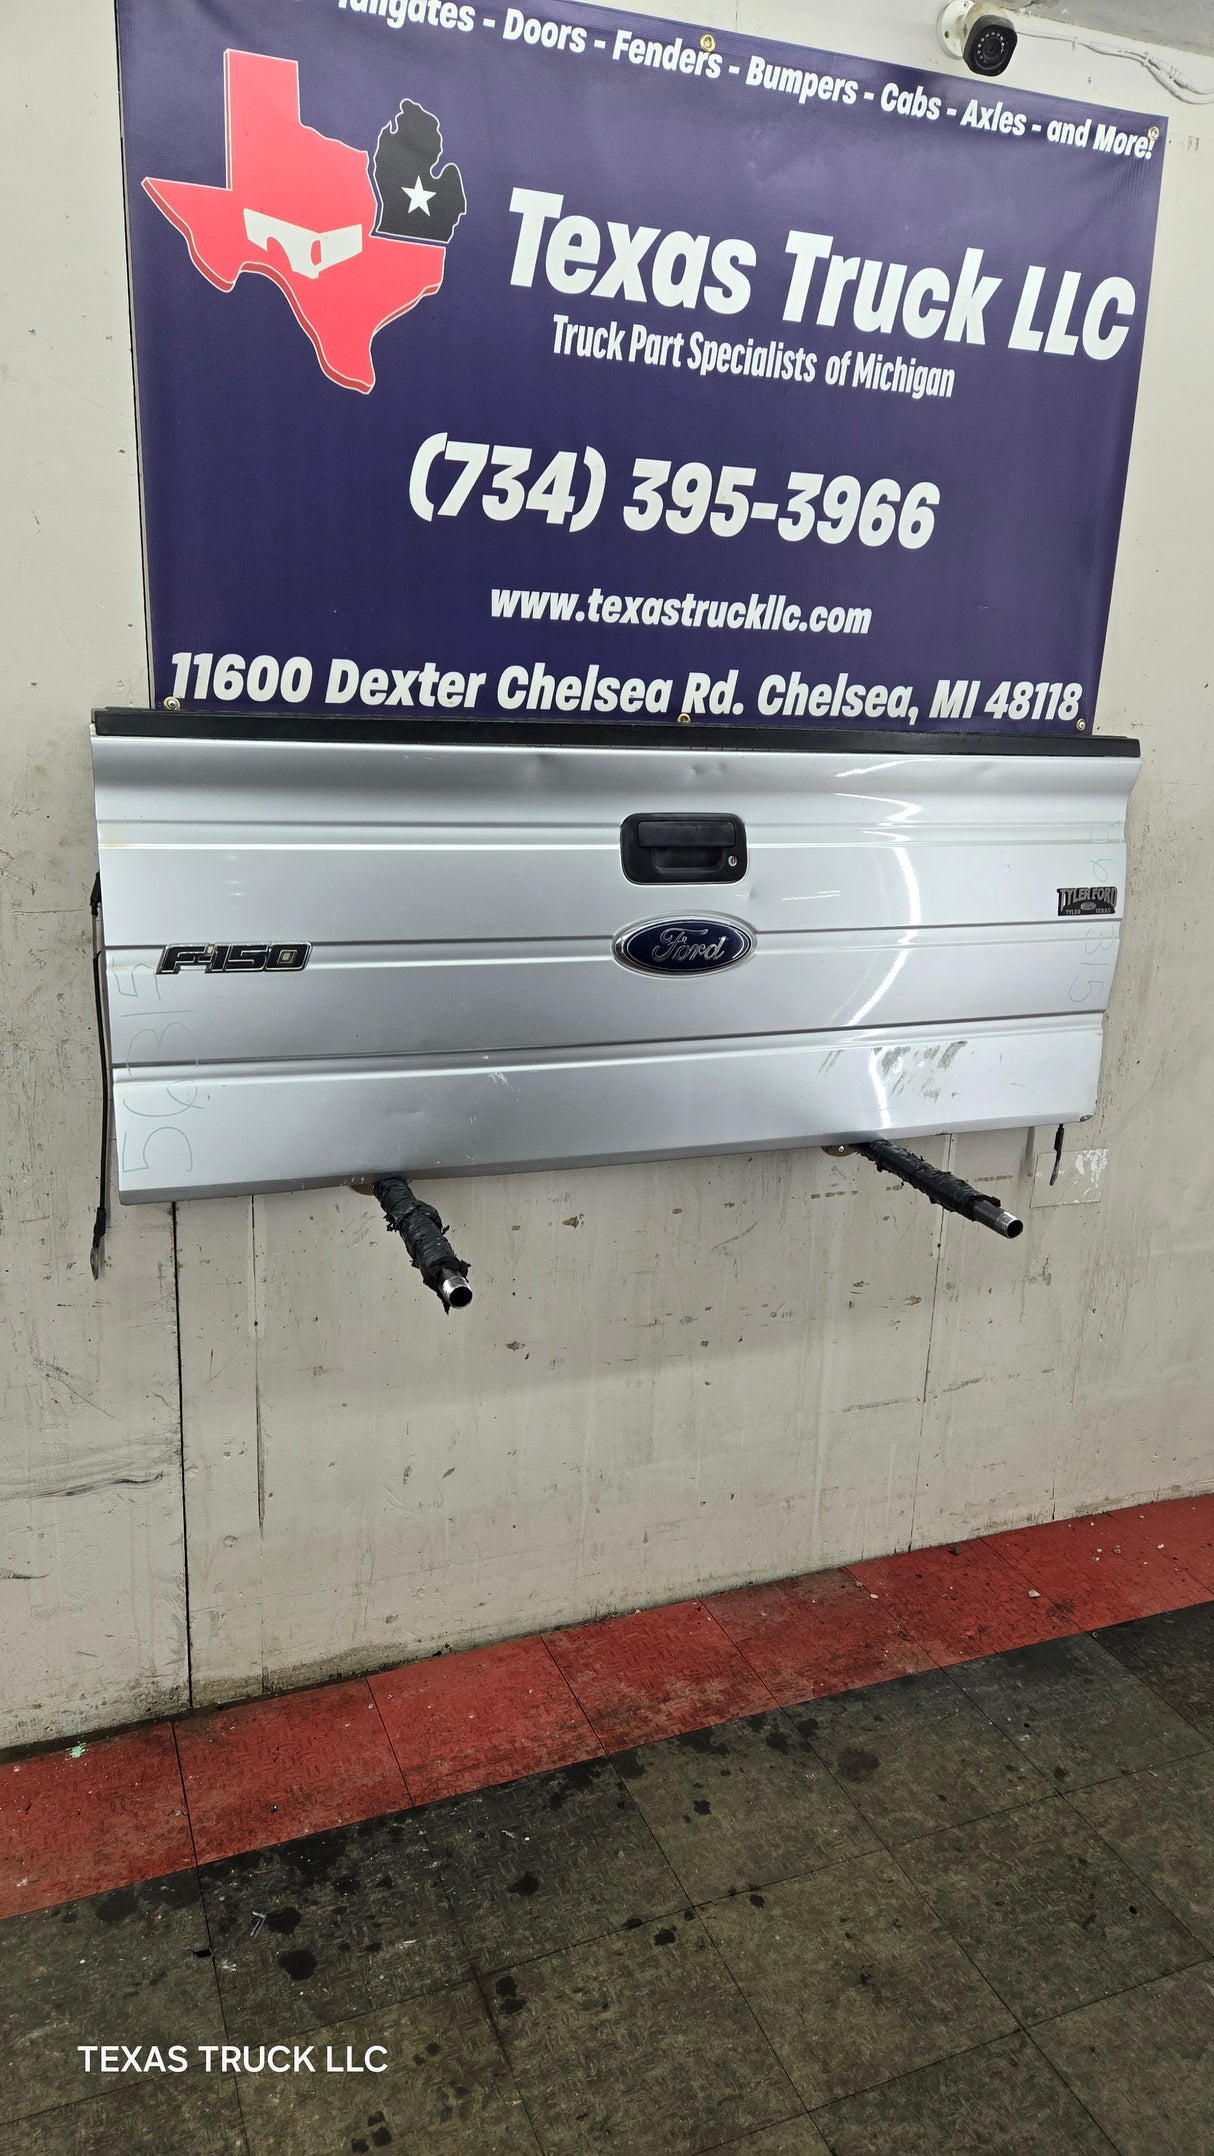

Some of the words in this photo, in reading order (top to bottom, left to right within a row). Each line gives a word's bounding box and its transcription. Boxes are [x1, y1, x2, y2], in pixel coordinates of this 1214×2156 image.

[339, 0, 475, 31] lgates
[503, 8, 587, 52] Doors
[613, 30, 722, 78] Fenders
[746, 56, 858, 104] Bumpers
[881, 83, 941, 120] Cabs
[960, 99, 1026, 135] Axles
[1047, 119, 1092, 147] and
[1093, 124, 1156, 159] More!
[510, 187, 756, 314] Texas
[783, 230, 1003, 345] Truck
[1008, 265, 1135, 360] LLC
[554, 315, 625, 360] Truck
[629, 324, 684, 367] Part
[687, 332, 817, 382] Specialists
[825, 351, 857, 386] of
[852, 352, 955, 399] Michigan
[410, 433, 606, 532] (734)
[624, 459, 940, 549] 395-3966
[492, 590, 871, 633] www.texastruckllc.com
[171, 653, 312, 702] 11600
[326, 659, 486, 707] Dexter
[498, 663, 672, 712] Chelsea
[682, 670, 743, 714] Rd.
[758, 672, 918, 725] Chelsea,
[929, 680, 980, 718] MI
[985, 682, 1083, 720] 48118
[1058, 888, 1091, 912] TYLER
[1091, 887, 1117, 908] FORD
[156, 941, 312, 974] F-150
[652, 927, 726, 962] Ford
